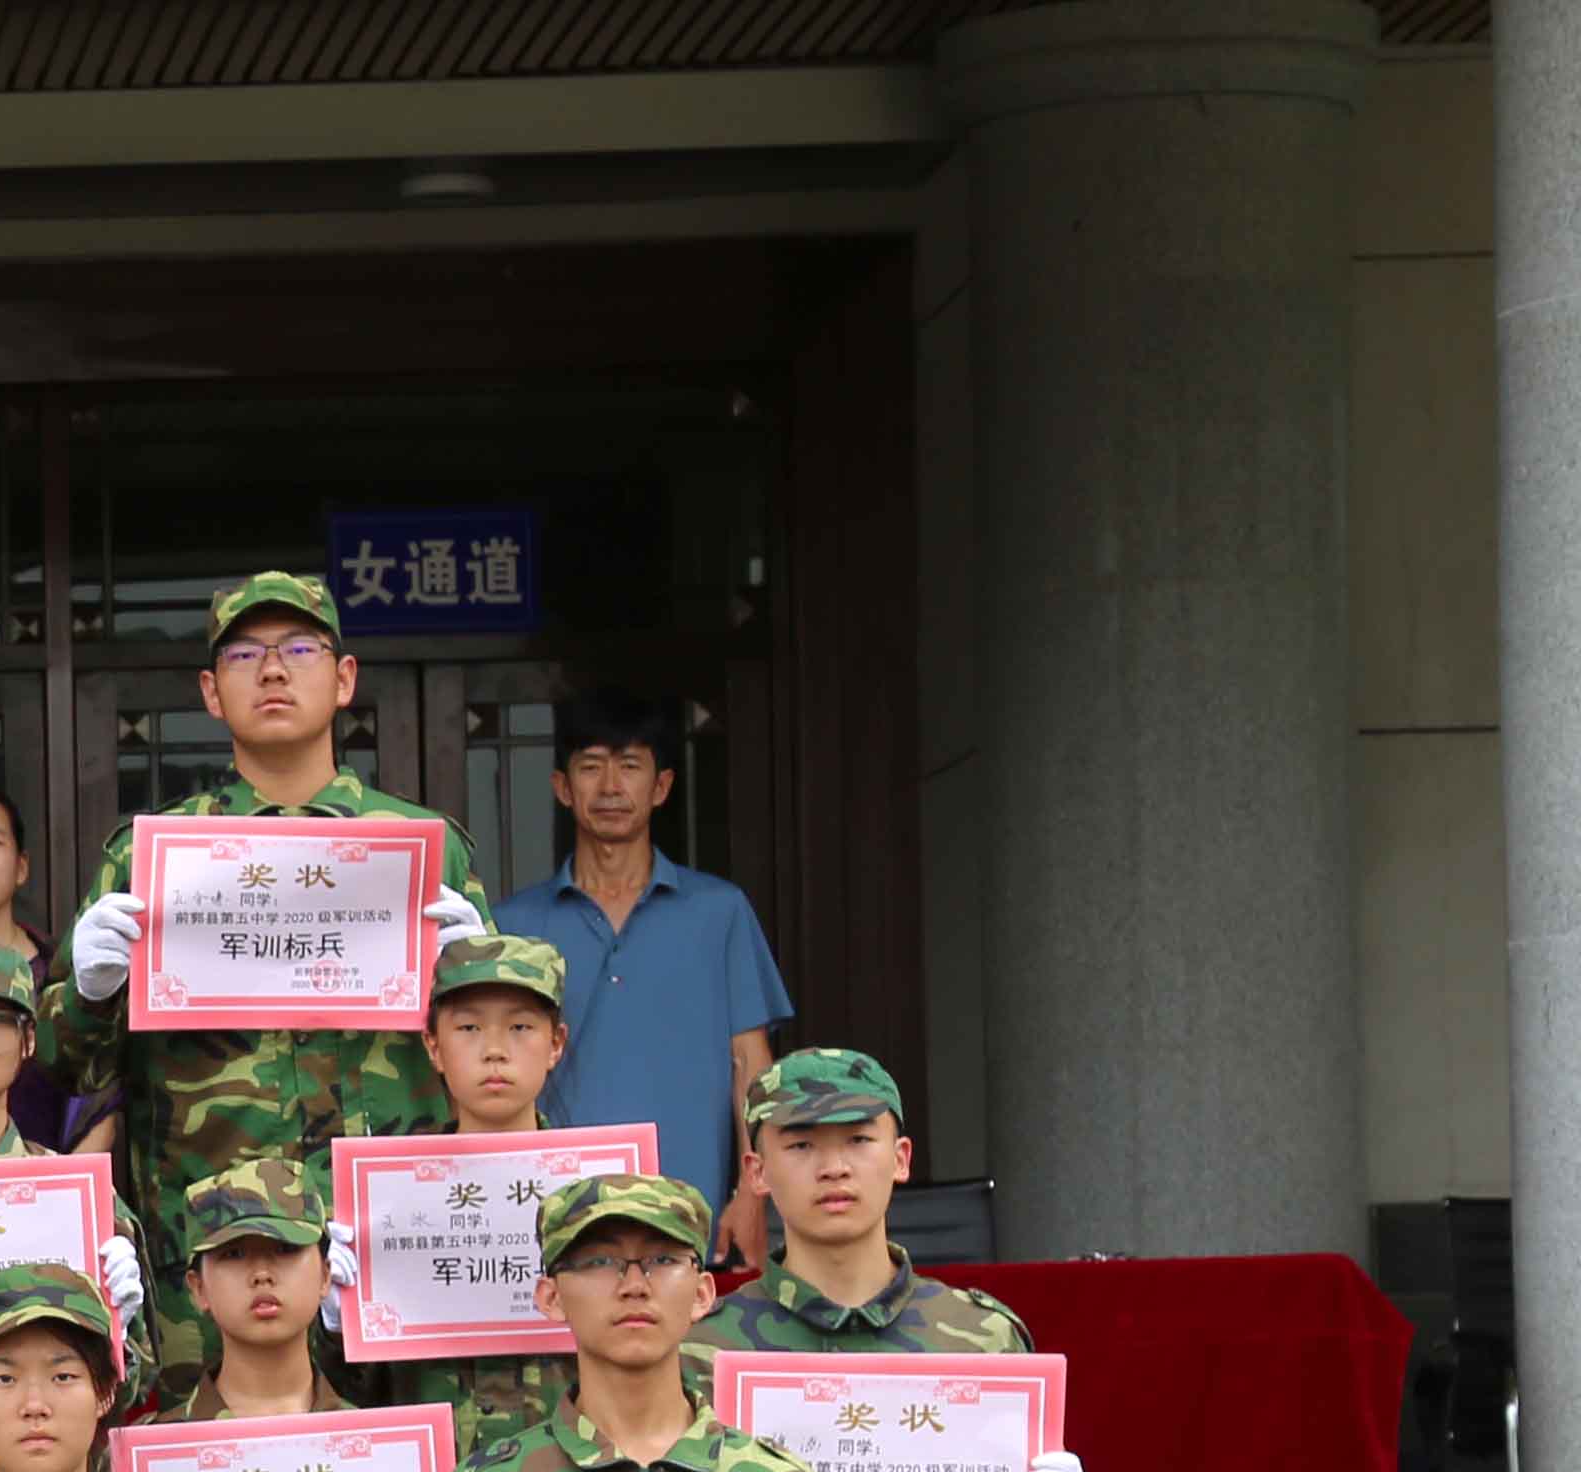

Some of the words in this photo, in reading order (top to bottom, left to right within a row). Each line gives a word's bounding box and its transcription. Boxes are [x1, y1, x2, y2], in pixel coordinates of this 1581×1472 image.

[342, 537, 522, 607] 女通道
[237, 864, 336, 889] 奖状
[220, 932, 345, 960] 军训标兵
[446, 1180, 545, 1209] 奖状
[432, 1256, 545, 1286] 军训标
[836, 1403, 945, 1433] 奖状
